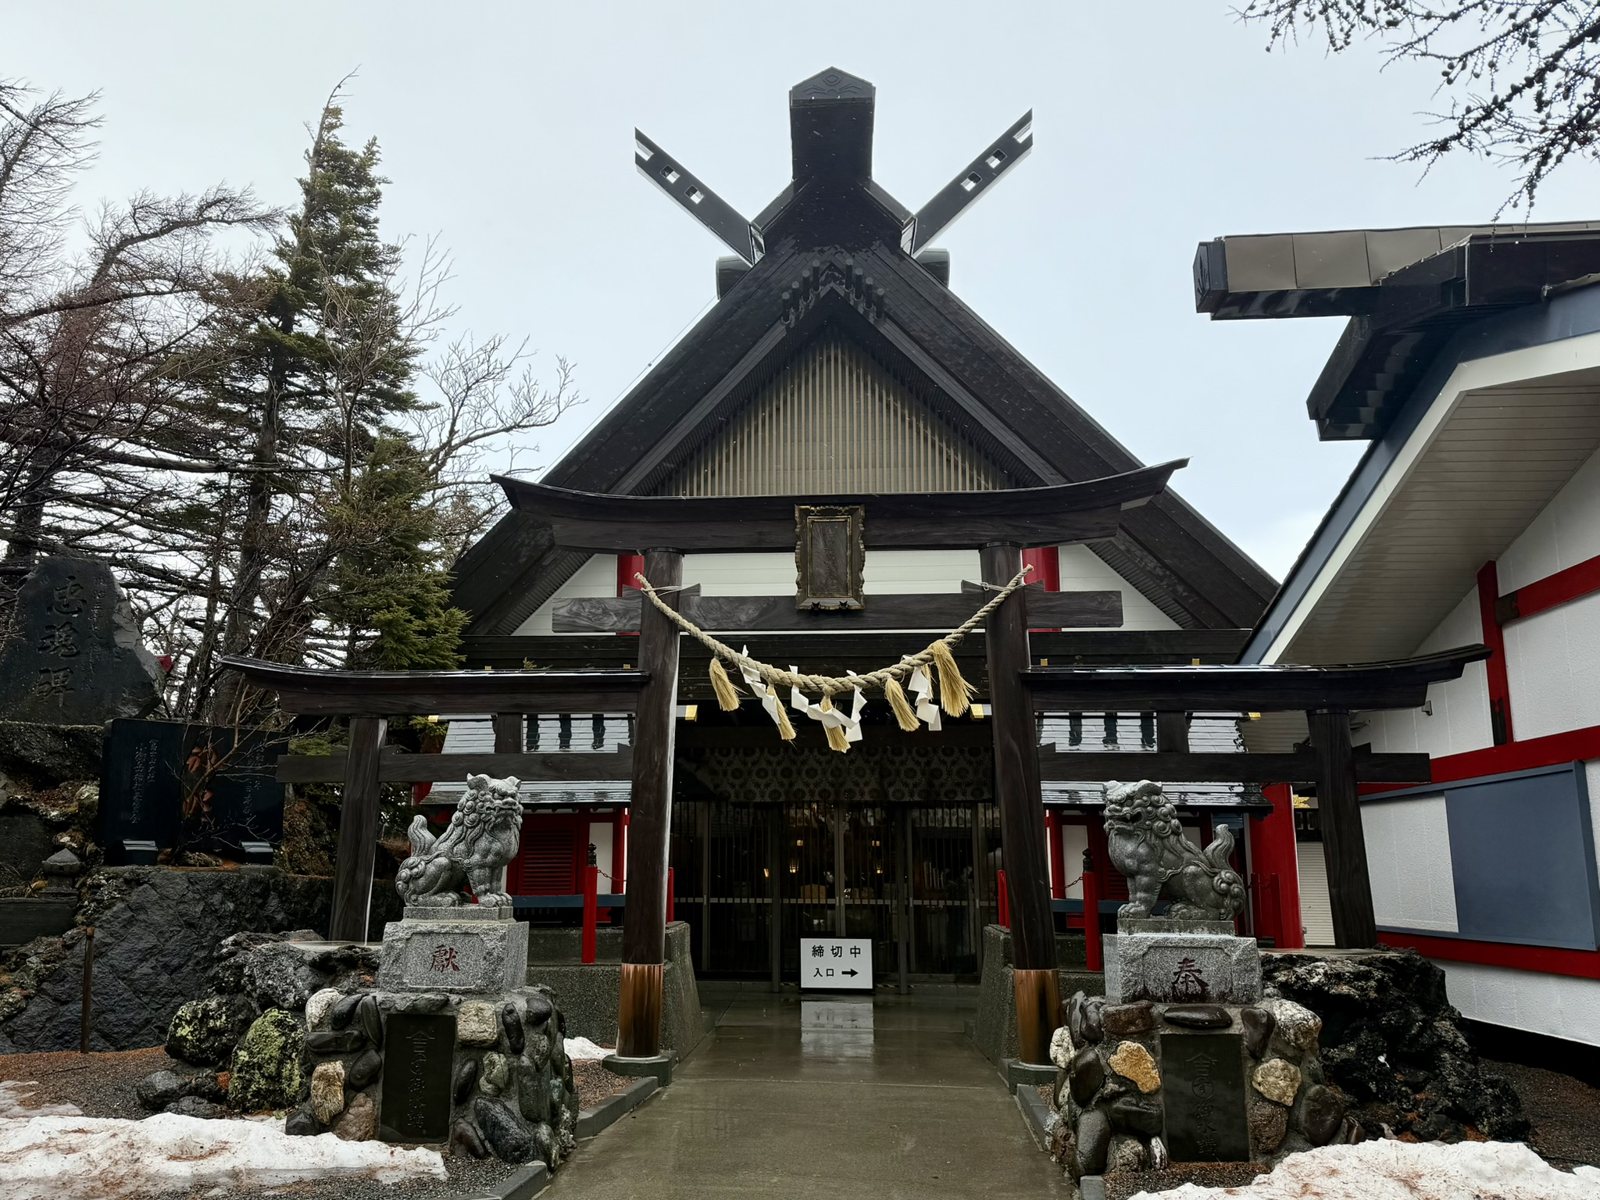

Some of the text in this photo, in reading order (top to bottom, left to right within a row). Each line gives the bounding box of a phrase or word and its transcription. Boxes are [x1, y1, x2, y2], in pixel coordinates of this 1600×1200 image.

[34, 575, 88, 707] 忠魂碑
[811, 944, 861, 958] 締切中
[813, 967, 835, 978] 入口
[1171, 957, 1209, 999] 奉
